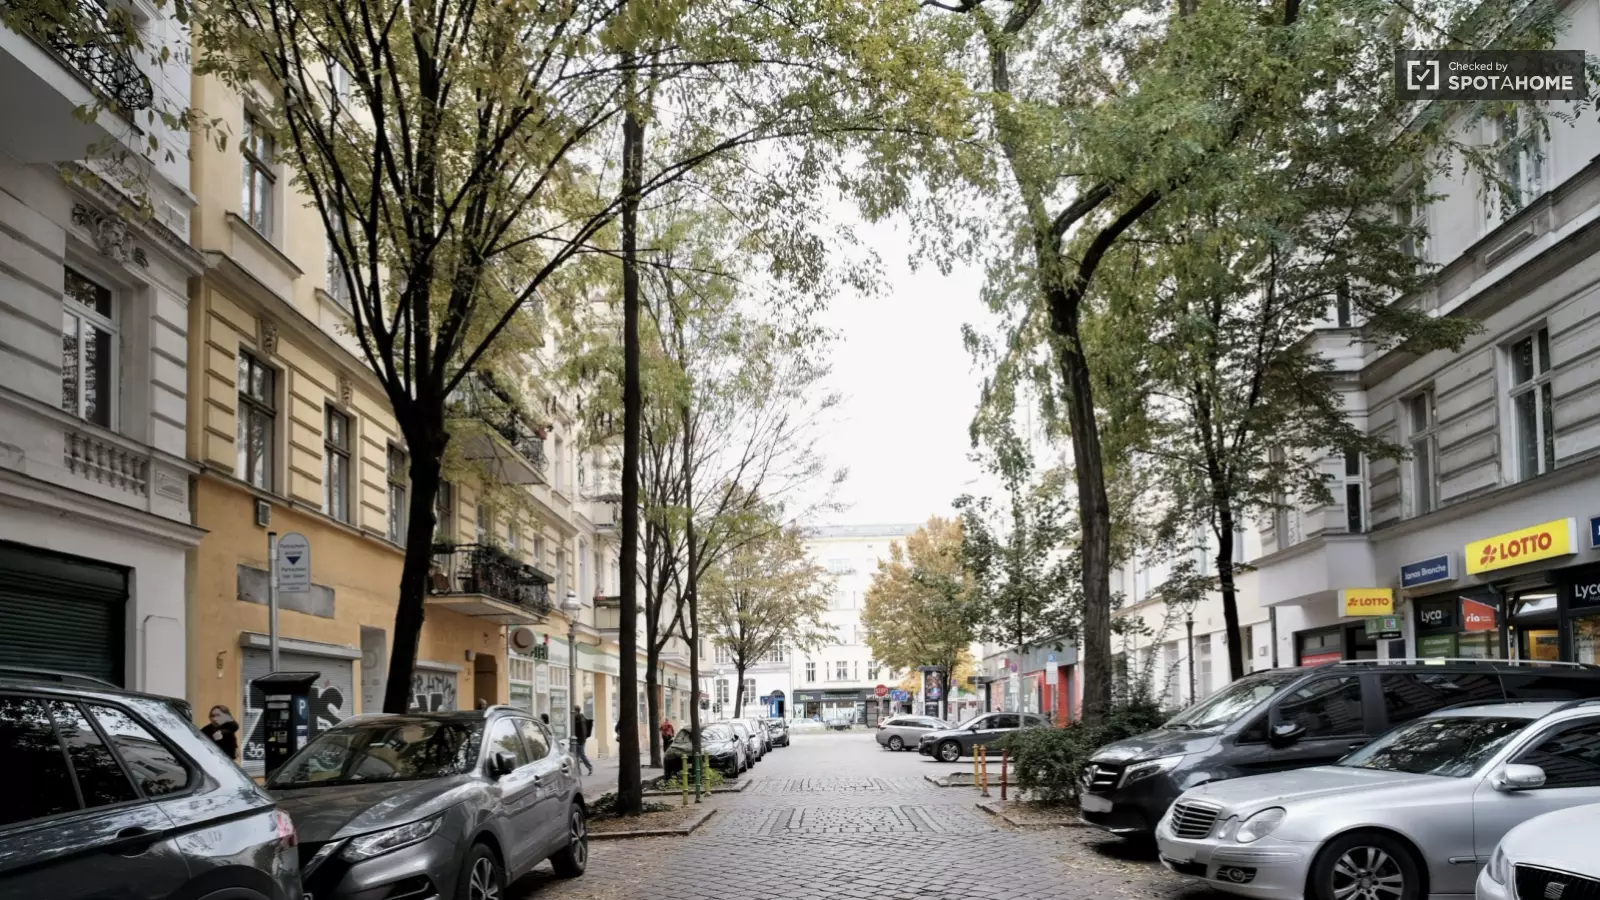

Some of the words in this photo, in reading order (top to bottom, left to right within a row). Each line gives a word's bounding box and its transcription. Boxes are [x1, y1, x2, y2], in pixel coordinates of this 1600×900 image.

[1500, 532, 1552, 560] LOTTO
[1360, 597, 1389, 607] LOTTO
[1421, 609, 1442, 623] Lyca
[1466, 612, 1480, 622] ria
